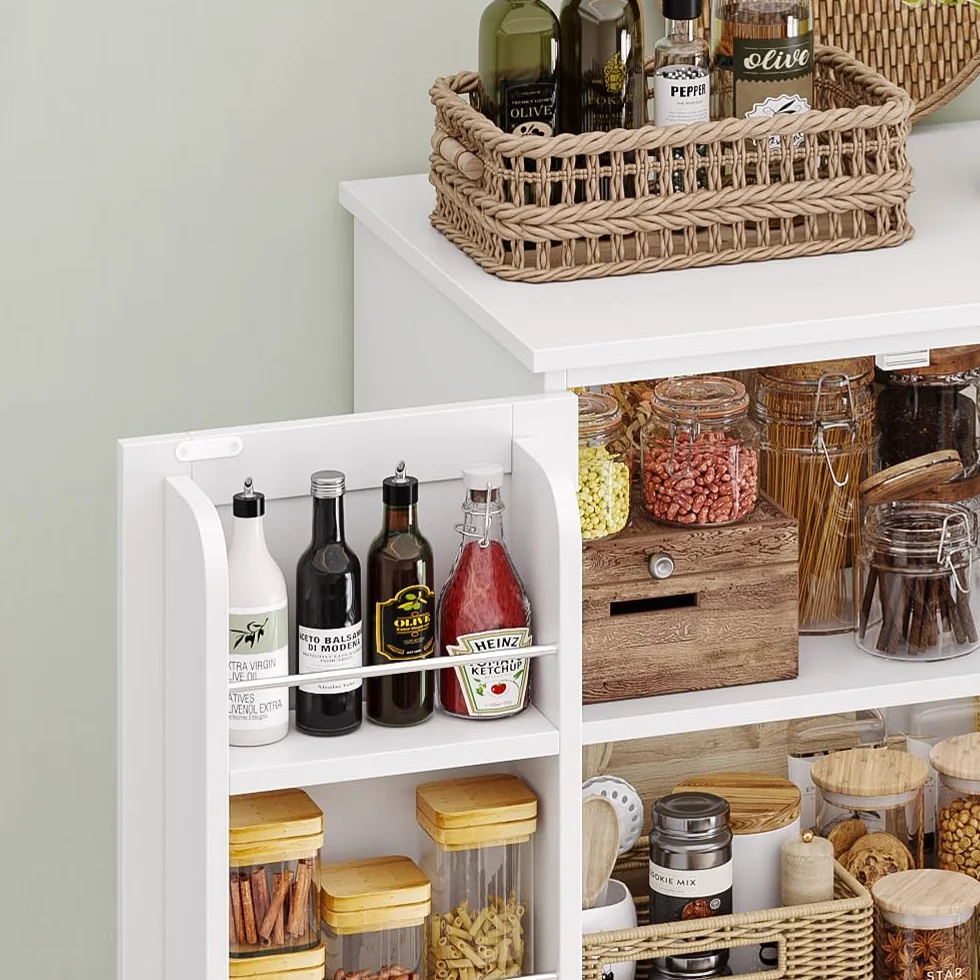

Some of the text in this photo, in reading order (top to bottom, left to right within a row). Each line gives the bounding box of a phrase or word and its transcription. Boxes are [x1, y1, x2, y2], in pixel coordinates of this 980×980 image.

[743, 49, 810, 70] olive
[671, 84, 706, 97] PEPPER
[510, 105, 553, 118] OLIVE
[394, 615, 430, 627] OLIVE
[308, 644, 317, 652] DI
[474, 637, 520, 651] HEINZ
[229, 659, 276, 670] TRA VIRGIN
[471, 661, 523, 675] KETCHUP
[229, 693, 255, 703] ATIVES
[260, 700, 282, 713] EXTRA
[650, 871, 673, 884] OOKIE
